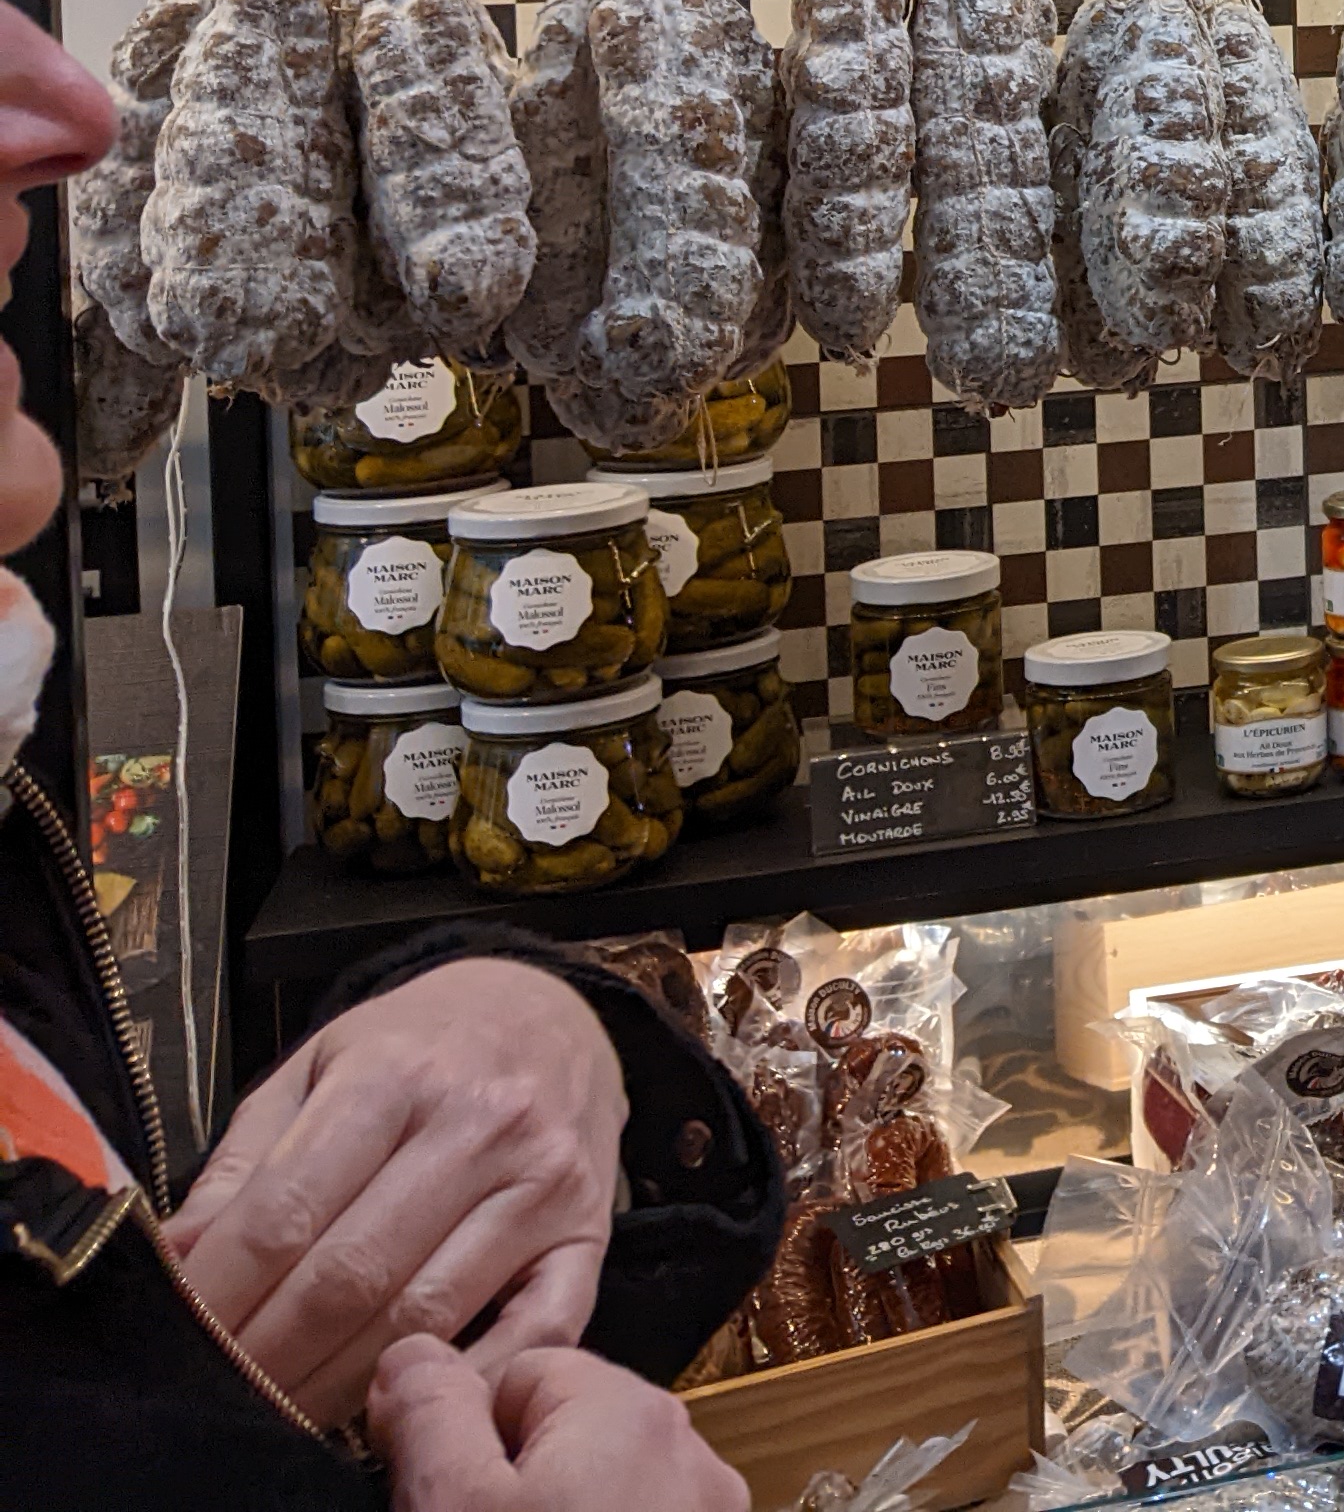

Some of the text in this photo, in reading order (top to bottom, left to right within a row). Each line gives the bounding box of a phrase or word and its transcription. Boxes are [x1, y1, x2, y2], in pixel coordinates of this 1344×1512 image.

[366, 561, 427, 575] MAISON
[373, 572, 419, 583] MARC
[509, 575, 572, 589] MAISON
[517, 586, 565, 598] MARC
[373, 593, 419, 607] Malossol
[517, 607, 565, 622] Malossol
[907, 648, 963, 664] MAISON
[915, 659, 957, 672] MARC
[1090, 728, 1144, 744] MAISON
[1098, 739, 1138, 752] MARC
[837, 752, 954, 780] CORNICHONS
[526, 767, 589, 783] MAISON
[533, 778, 581, 792] MARC
[535, 801, 581, 815] Malossol
[840, 824, 923, 847] MOUTARDE
